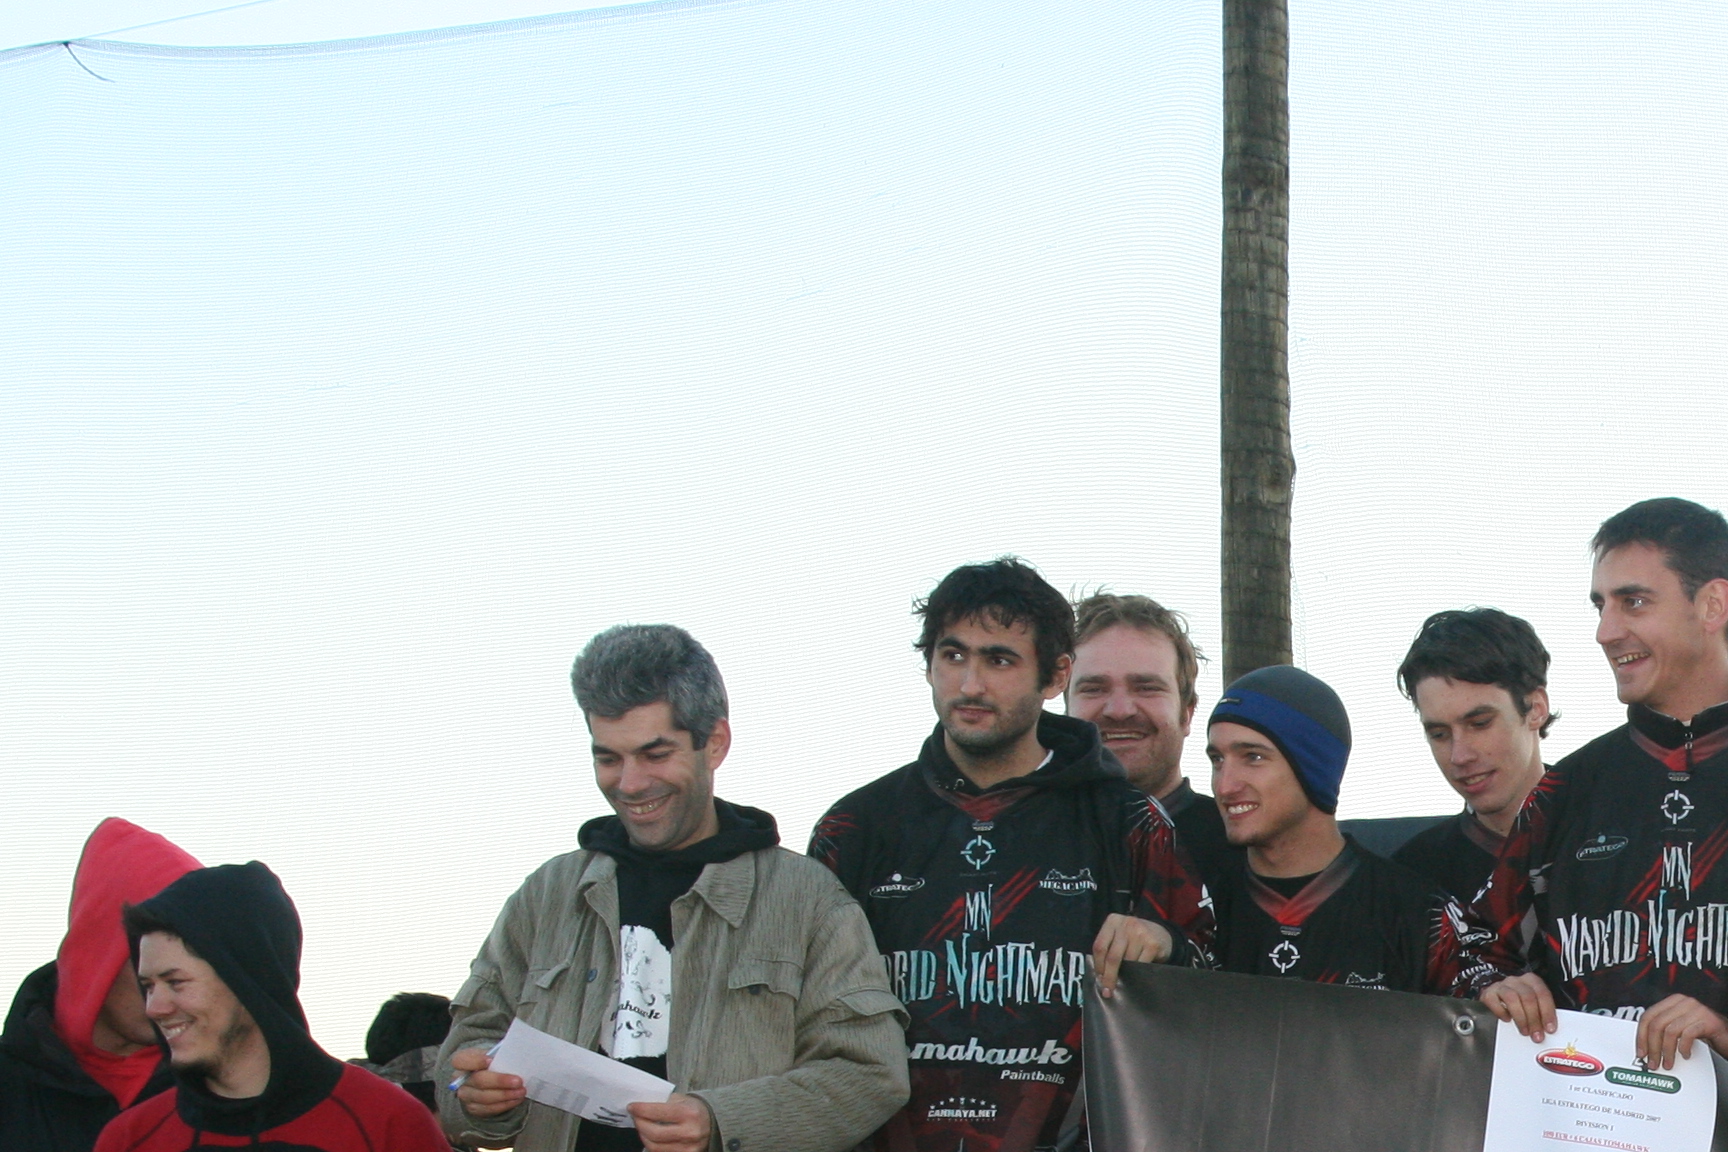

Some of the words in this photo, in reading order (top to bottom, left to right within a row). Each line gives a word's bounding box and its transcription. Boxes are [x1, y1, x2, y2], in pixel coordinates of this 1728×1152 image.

[1543, 1056, 1596, 1071] ESTRATEGO
[1000, 1069, 1066, 1085] Paintballs
[1612, 1070, 1674, 1090] TOMAHAWK
[1582, 1087, 1634, 1101] CLASIFICADO
[1542, 1097, 1557, 1106] LIGA
[1558, 1099, 1600, 1112] ESTRATEGO
[1601, 1106, 1612, 1114] DE
[1613, 1108, 1645, 1120] MADRID
